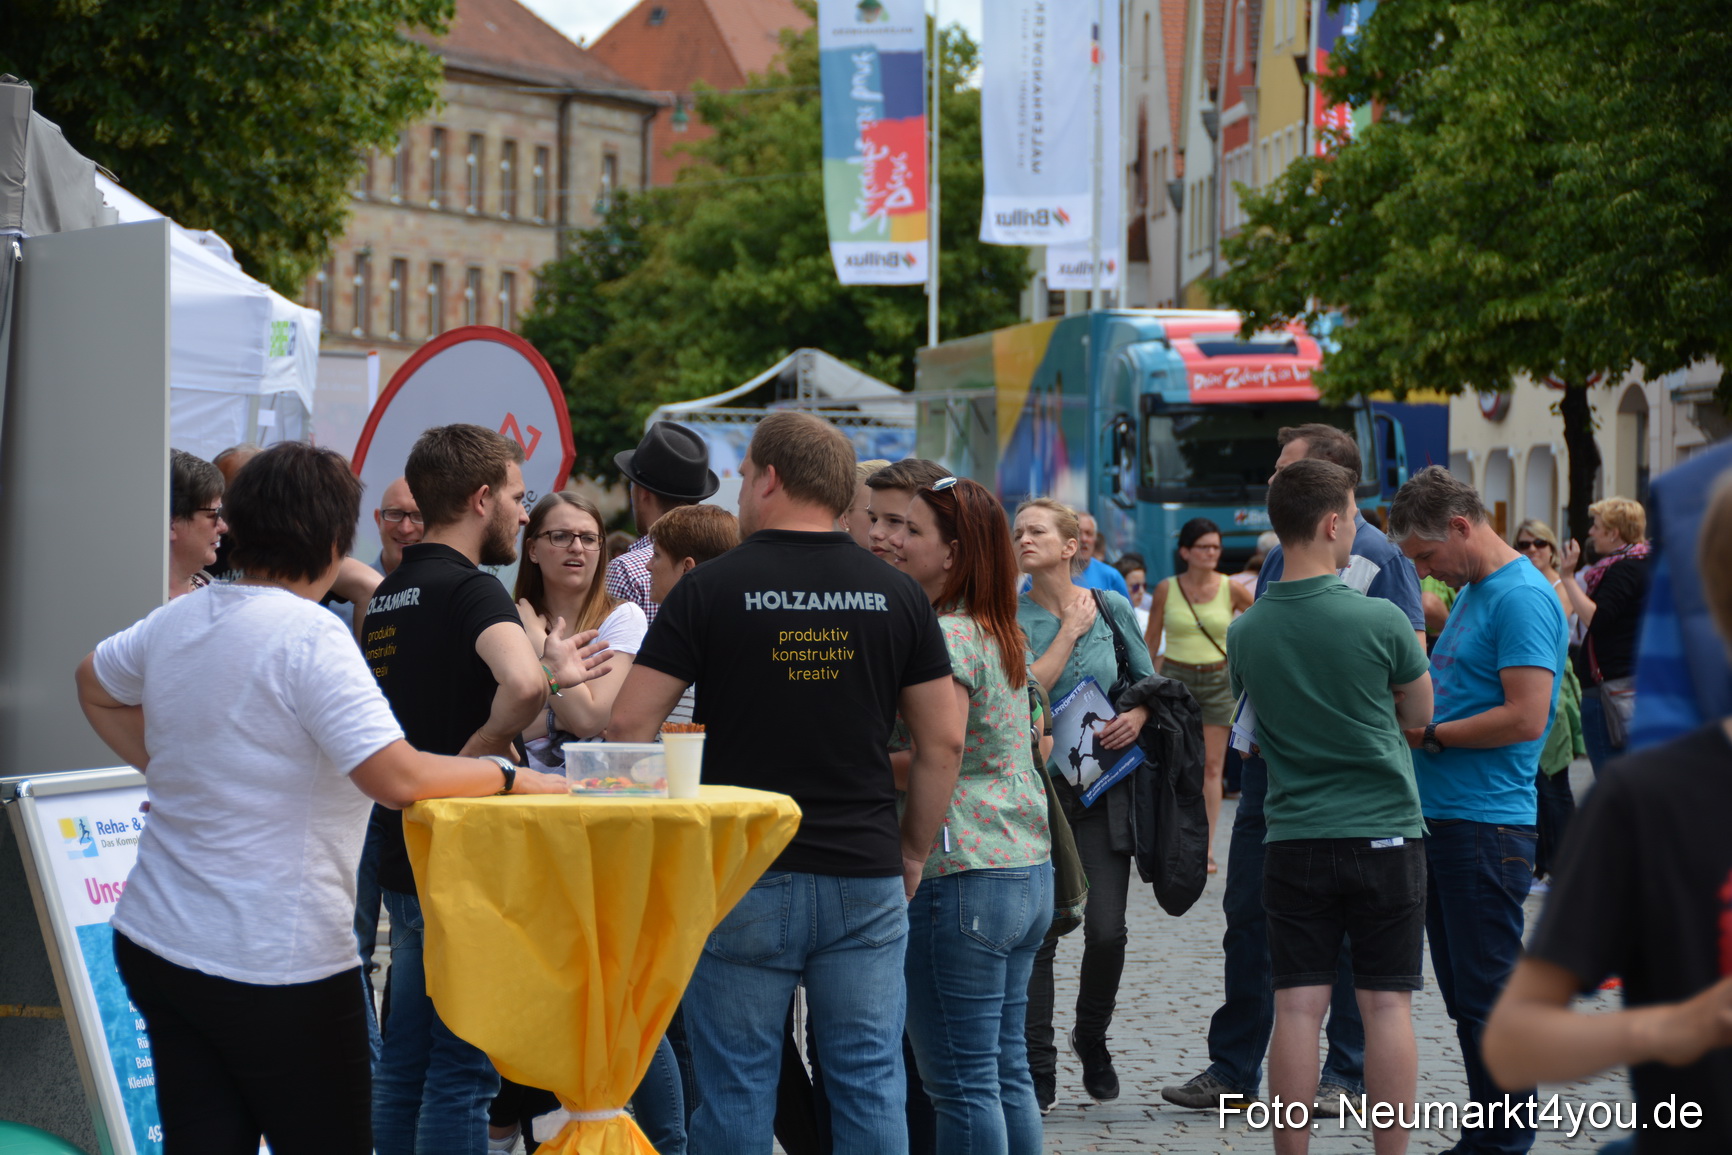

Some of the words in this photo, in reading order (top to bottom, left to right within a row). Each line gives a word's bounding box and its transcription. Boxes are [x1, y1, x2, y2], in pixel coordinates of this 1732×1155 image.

[366, 587, 421, 616] OLZAMMER
[744, 590, 888, 612] HOLZAMMER
[779, 626, 850, 645] produktiv
[772, 646, 855, 662] konstruktiv
[788, 665, 840, 681] kreativ
[96, 818, 129, 835] Reha-
[131, 817, 143, 831] &
[101, 839, 115, 848] Das
[116, 836, 139, 848] Kompl
[128, 1073, 155, 1089] Kleinki
